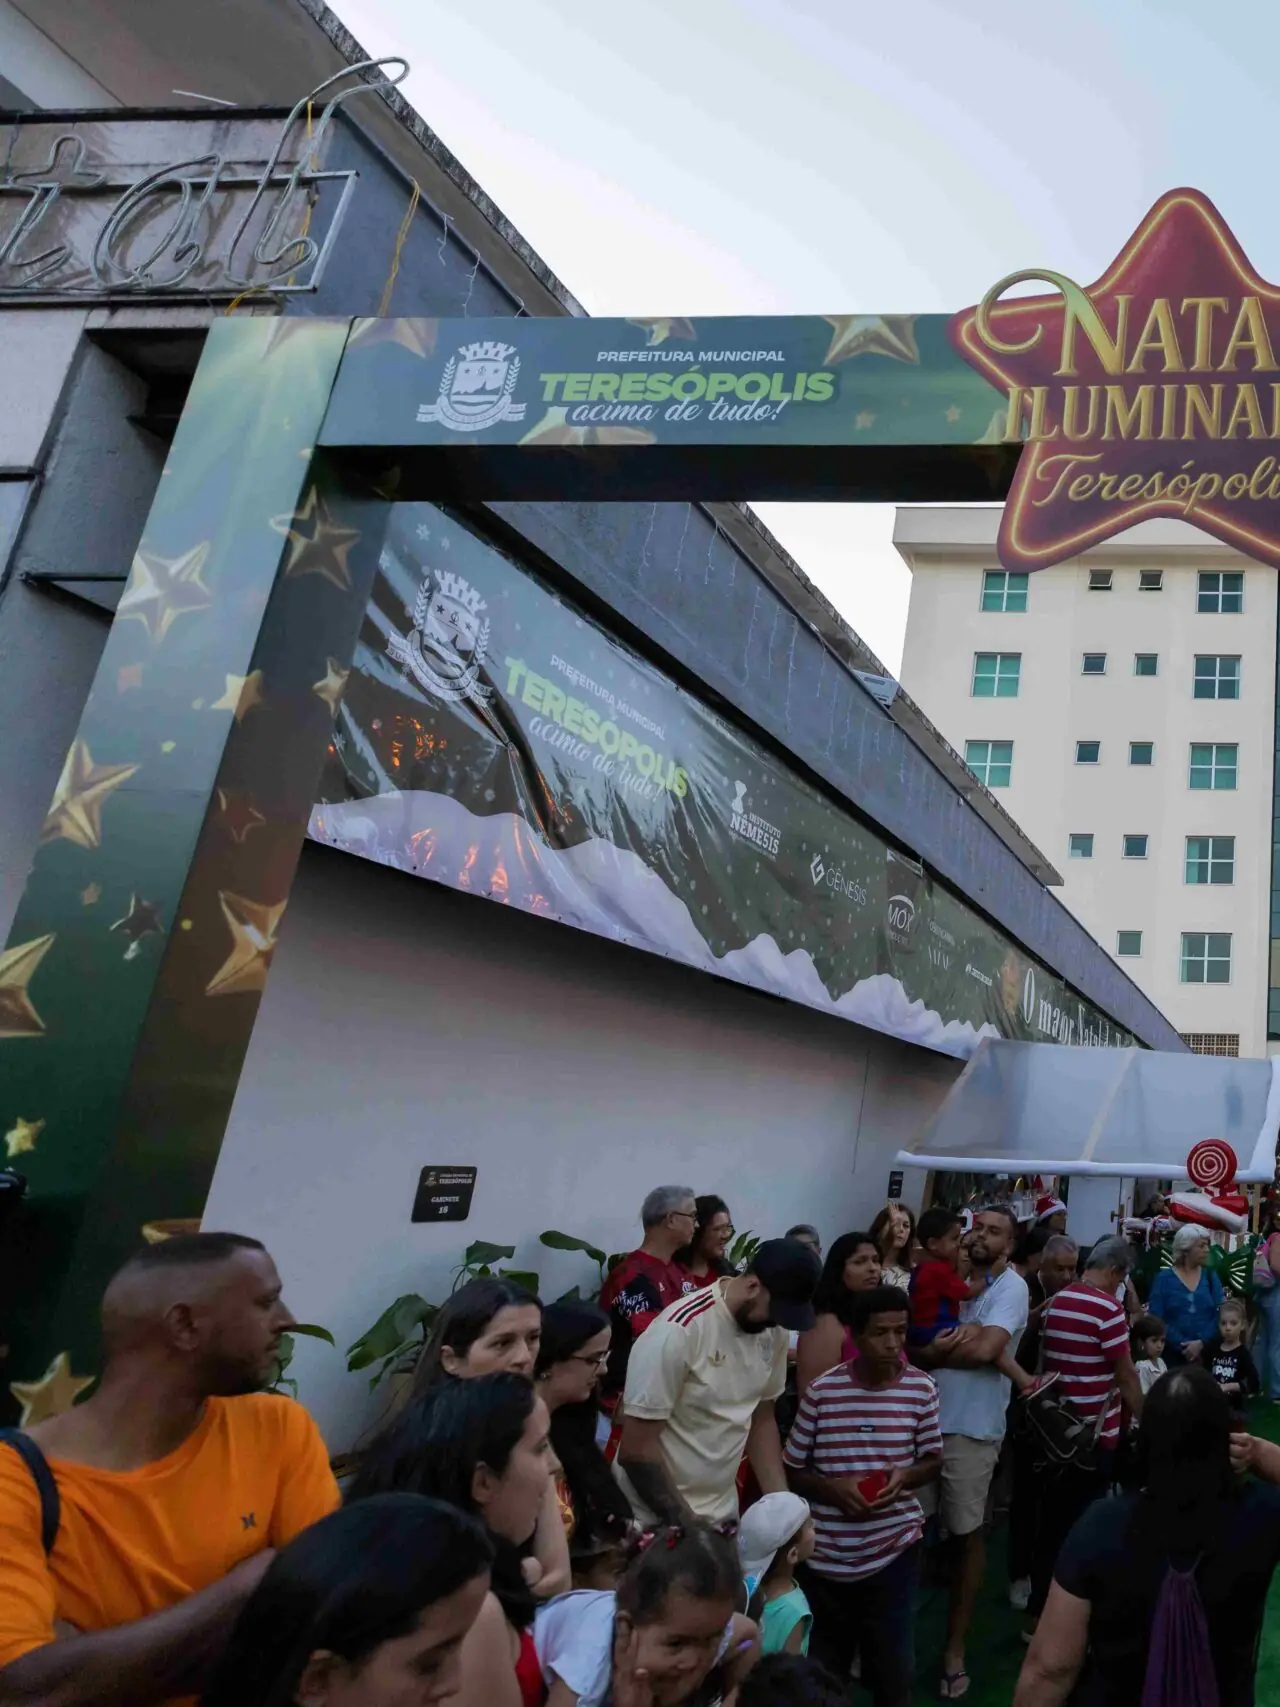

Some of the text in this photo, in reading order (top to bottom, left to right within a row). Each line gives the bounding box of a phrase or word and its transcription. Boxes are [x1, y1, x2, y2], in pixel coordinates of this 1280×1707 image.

[596, 350, 786, 363] PREFEITURA MUNICIPAL
[538, 365, 836, 402] TERESÓPOLIS
[570, 394, 787, 423] acima de tudo!
[551, 654, 616, 706] PREFEITURA
[616, 698, 666, 742] MUNICIPAL
[592, 753, 616, 777] de
[749, 812, 782, 839] INSTITUTO
[826, 867, 867, 906] GÊNESIS
[1023, 967, 1035, 1025] O
